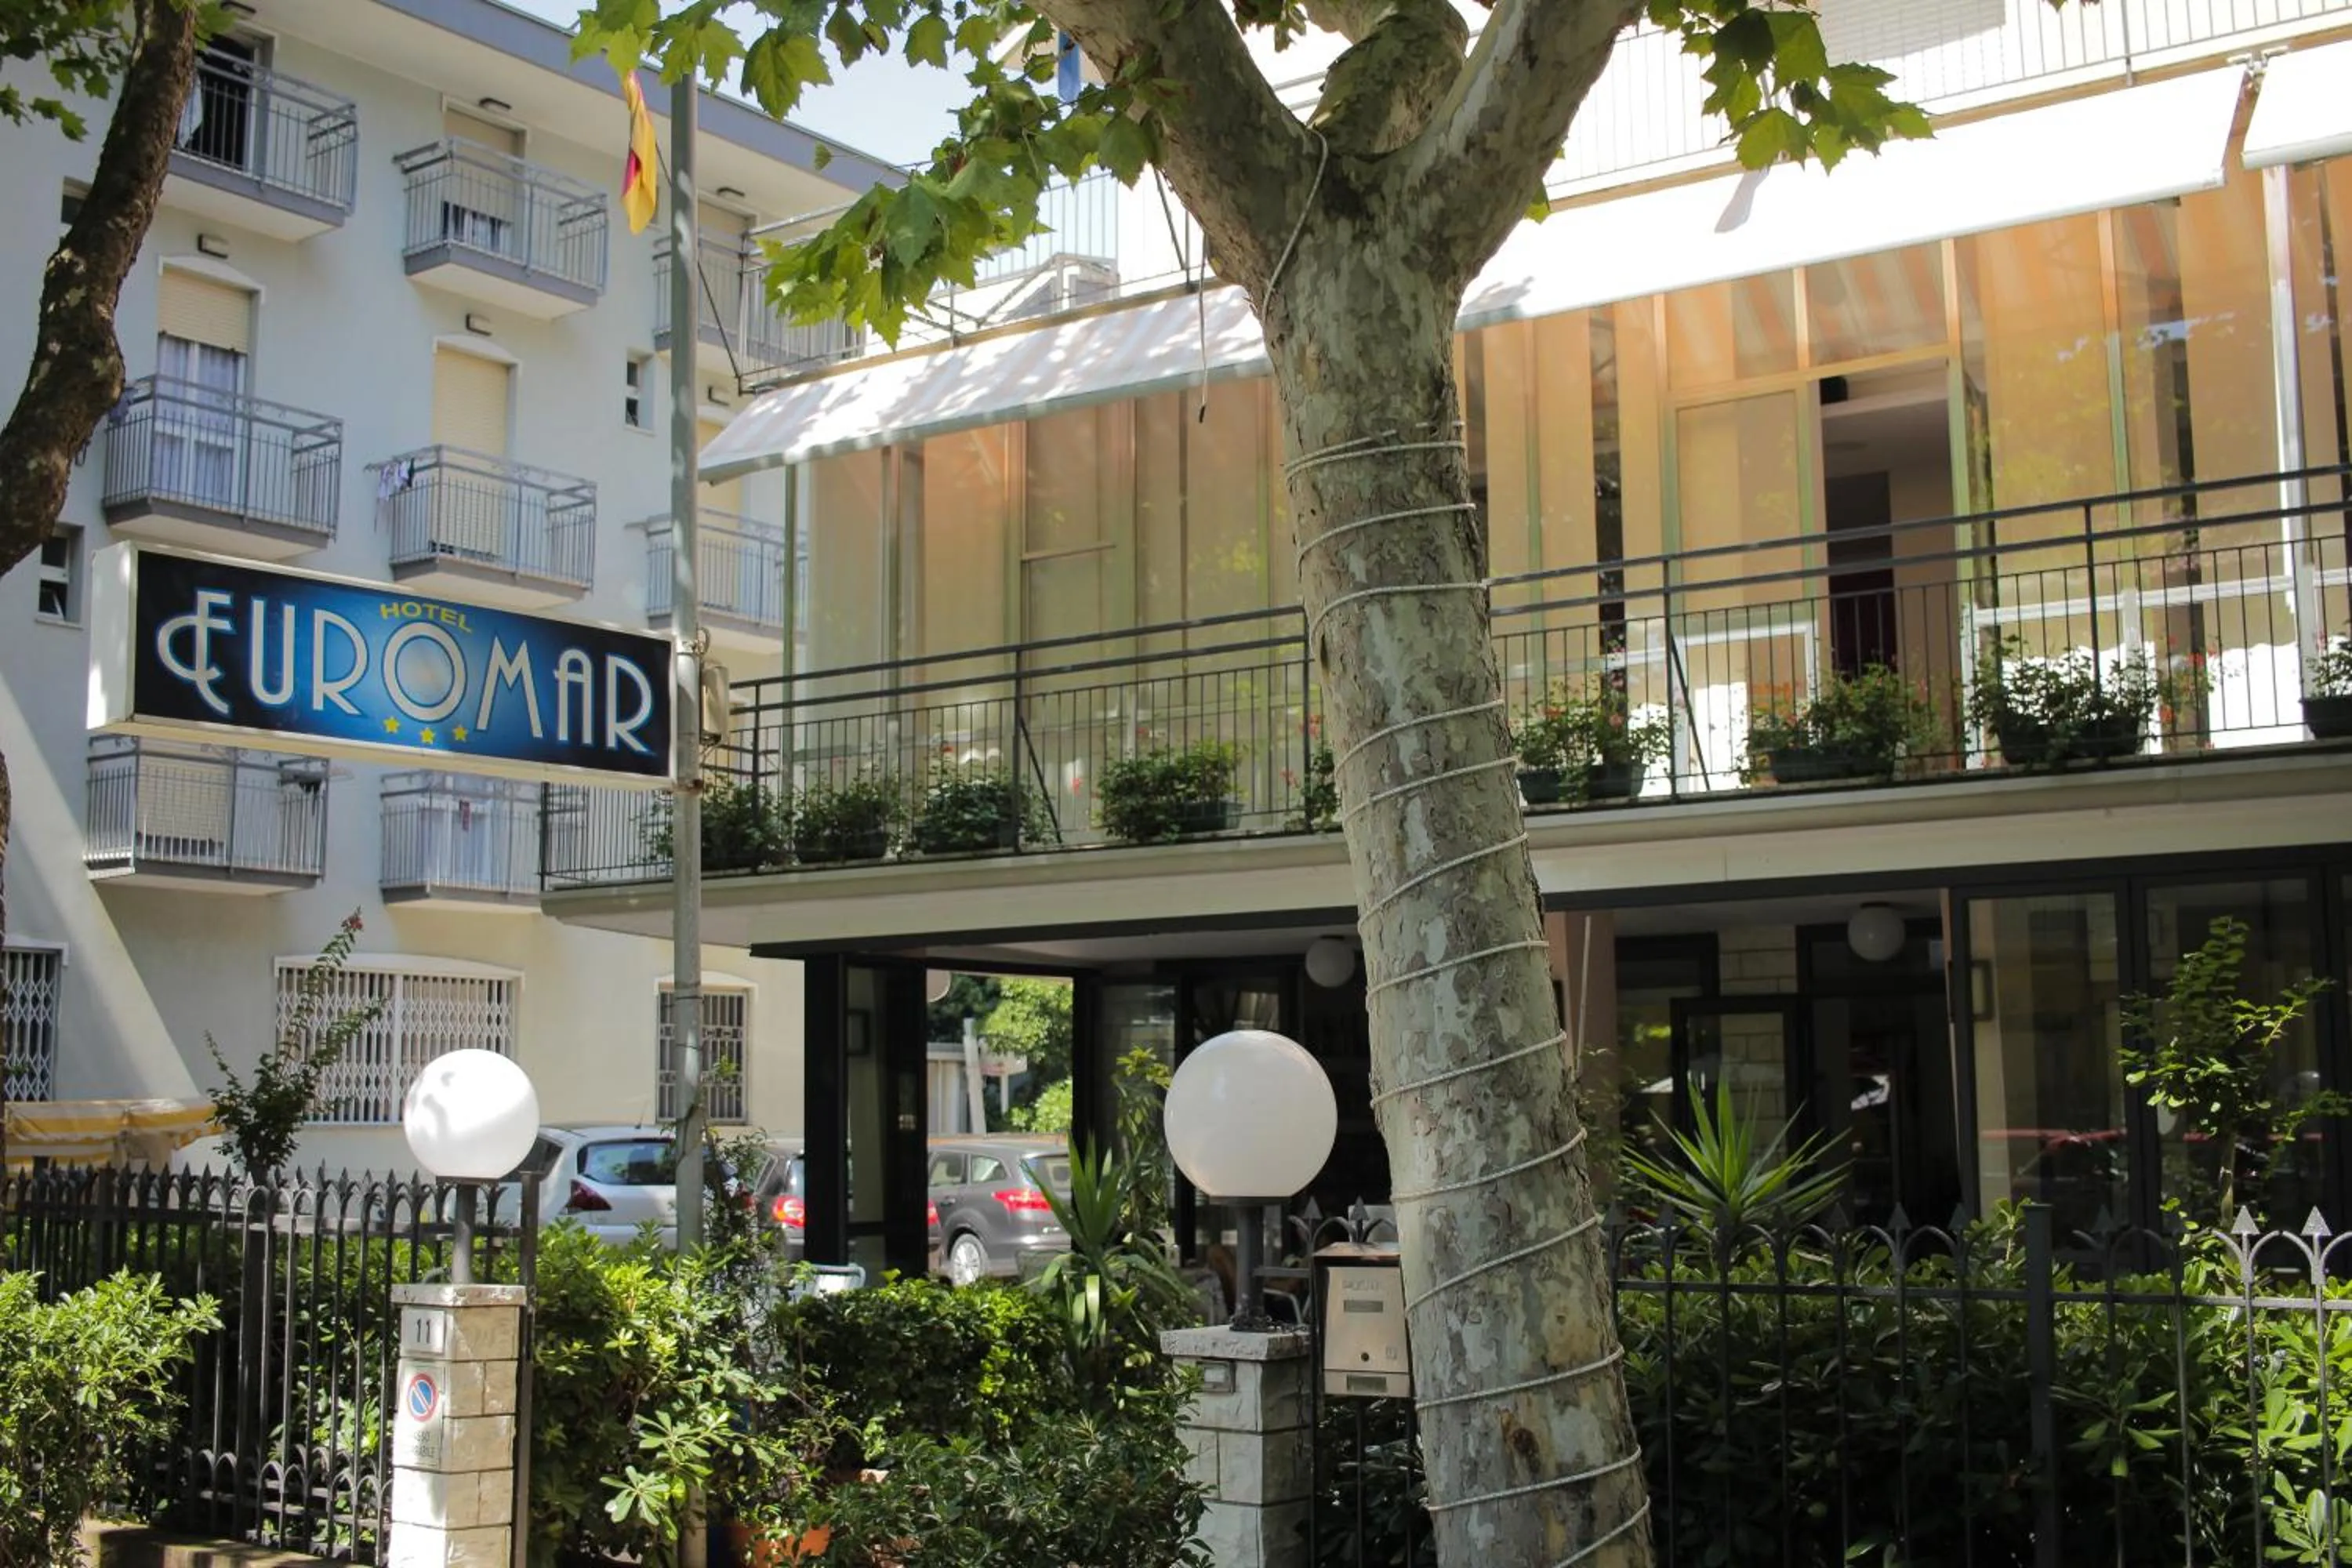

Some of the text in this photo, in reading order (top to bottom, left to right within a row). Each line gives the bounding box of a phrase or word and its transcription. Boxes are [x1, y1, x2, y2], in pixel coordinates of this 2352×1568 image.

[380, 601, 472, 633] HOTEL
[156, 590, 654, 754] EUROMAR
[416, 1318, 430, 1345] 11
